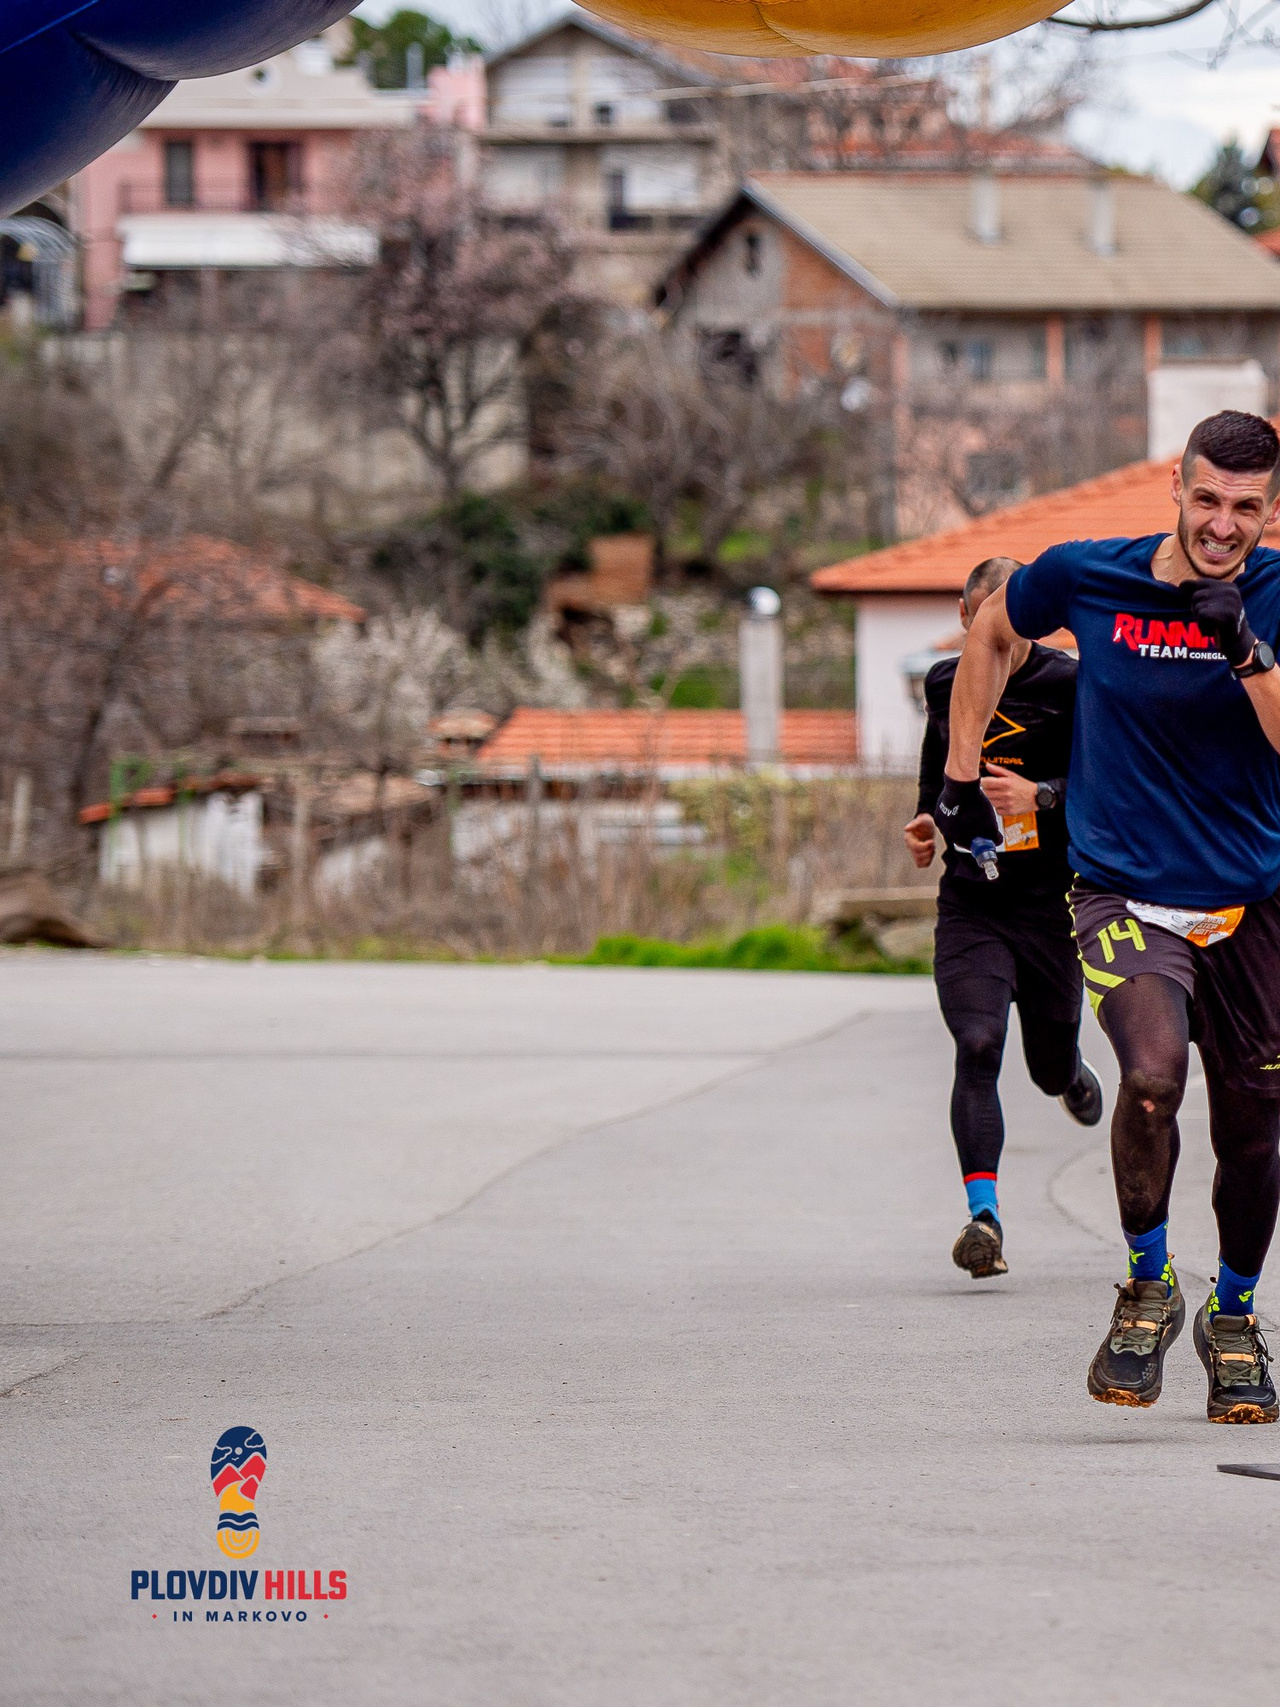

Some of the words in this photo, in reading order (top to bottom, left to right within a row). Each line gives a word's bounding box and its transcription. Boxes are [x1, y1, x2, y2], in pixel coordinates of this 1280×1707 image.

[1138, 644, 1187, 659] TEAM
[1189, 651, 1227, 660] CONEGL
[1097, 918, 1146, 964] 14
